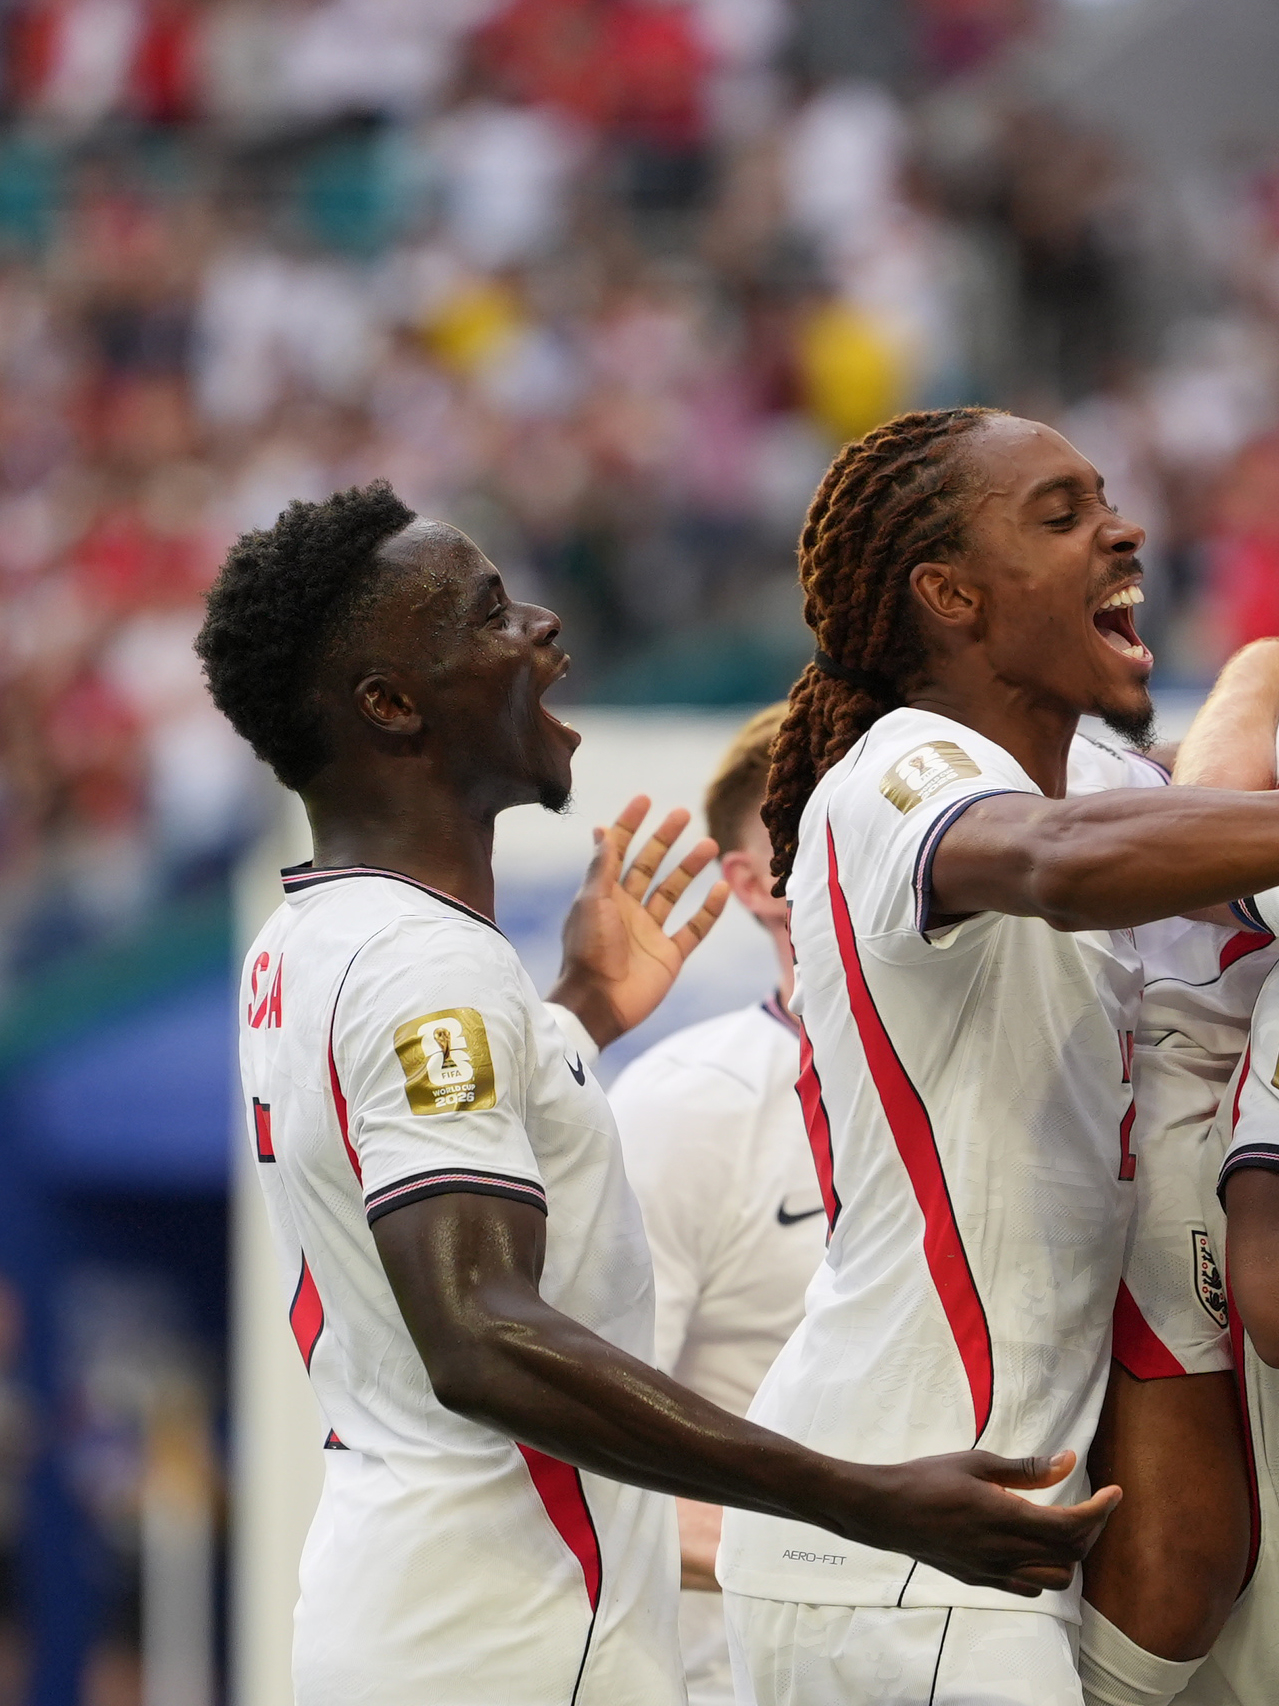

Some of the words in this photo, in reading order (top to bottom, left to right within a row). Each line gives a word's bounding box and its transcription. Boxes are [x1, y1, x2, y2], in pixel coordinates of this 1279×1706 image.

[441, 1069, 462, 1079] FIFA
[432, 1084, 461, 1097] WORLD
[461, 1084, 476, 1092] CUP
[434, 1092, 475, 1108] 2026
[782, 1549, 848, 1566] AERO-FIT
